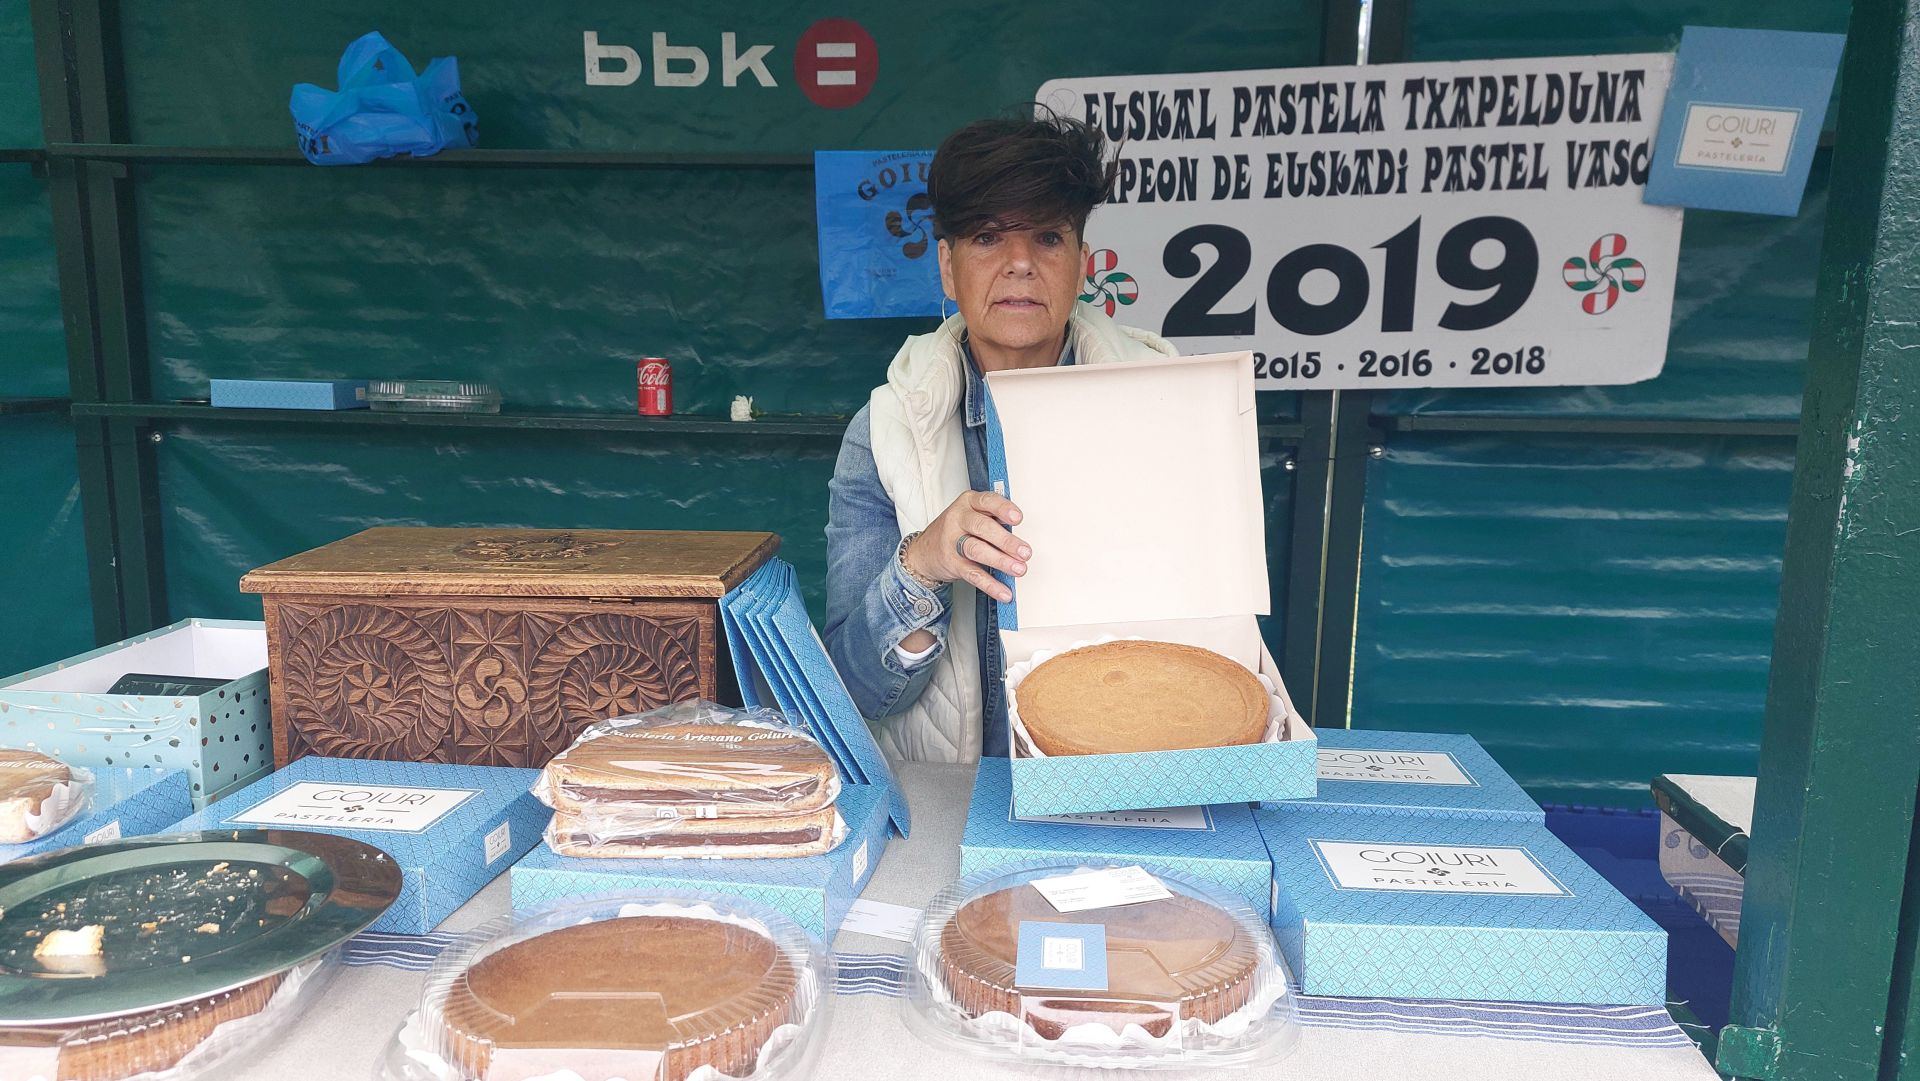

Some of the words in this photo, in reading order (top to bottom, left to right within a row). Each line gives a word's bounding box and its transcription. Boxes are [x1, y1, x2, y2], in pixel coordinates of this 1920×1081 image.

[583, 31, 779, 87] bbk
[1083, 90, 1218, 143] EUSKAL
[1229, 80, 1387, 138] PASTELA
[1402, 69, 1645, 131] TXAPELDUNA
[1705, 114, 1777, 136] GOIURI
[857, 162, 930, 201] GOIU
[1105, 156, 1200, 204] PEON
[1210, 153, 1252, 201] DE
[1420, 141, 1549, 192] PASTEL
[1565, 138, 1650, 190] VASC
[1161, 214, 1539, 338] 2019
[1253, 351, 1322, 379] 2015
[1357, 349, 1434, 378] 2016
[1469, 345, 1546, 376] 2018
[312, 789, 436, 806] GOIURI
[1359, 849, 1499, 867] GOIURI
